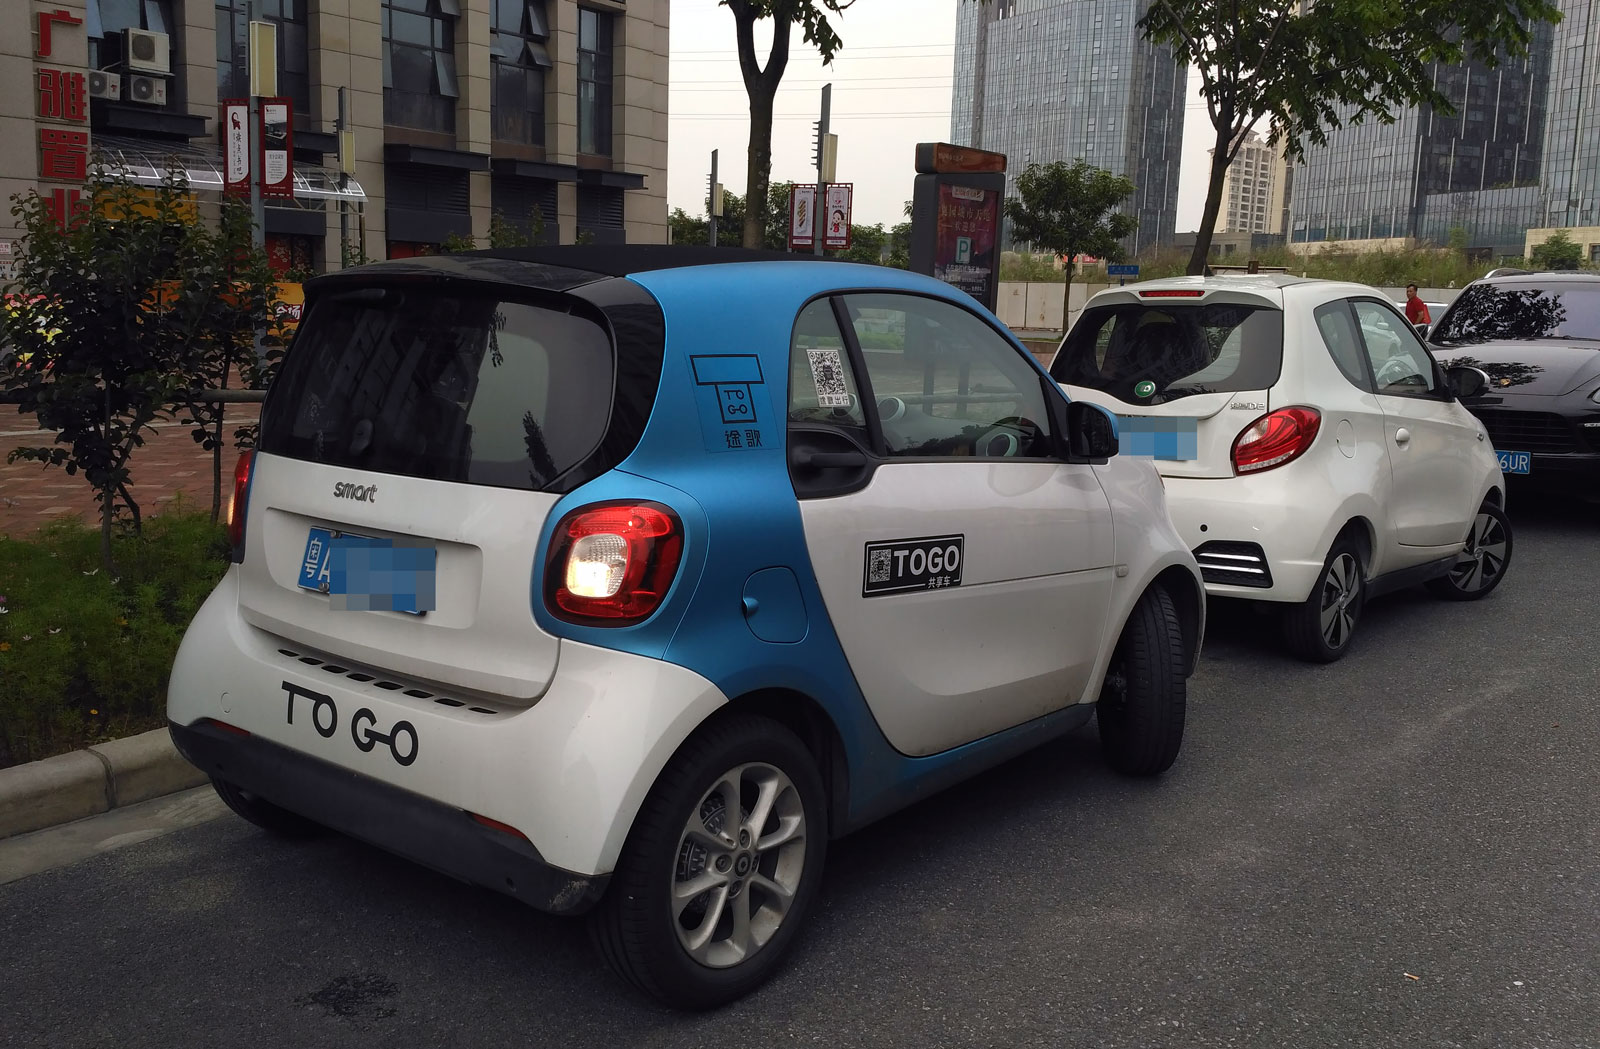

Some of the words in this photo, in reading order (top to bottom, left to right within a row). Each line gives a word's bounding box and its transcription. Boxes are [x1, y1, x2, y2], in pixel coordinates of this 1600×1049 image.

[727, 404, 748, 415] GO
[724, 429, 763, 449] 途歌
[333, 481, 378, 503] smart
[894, 545, 960, 577] TOGO
[928, 575, 951, 589] 共享车
